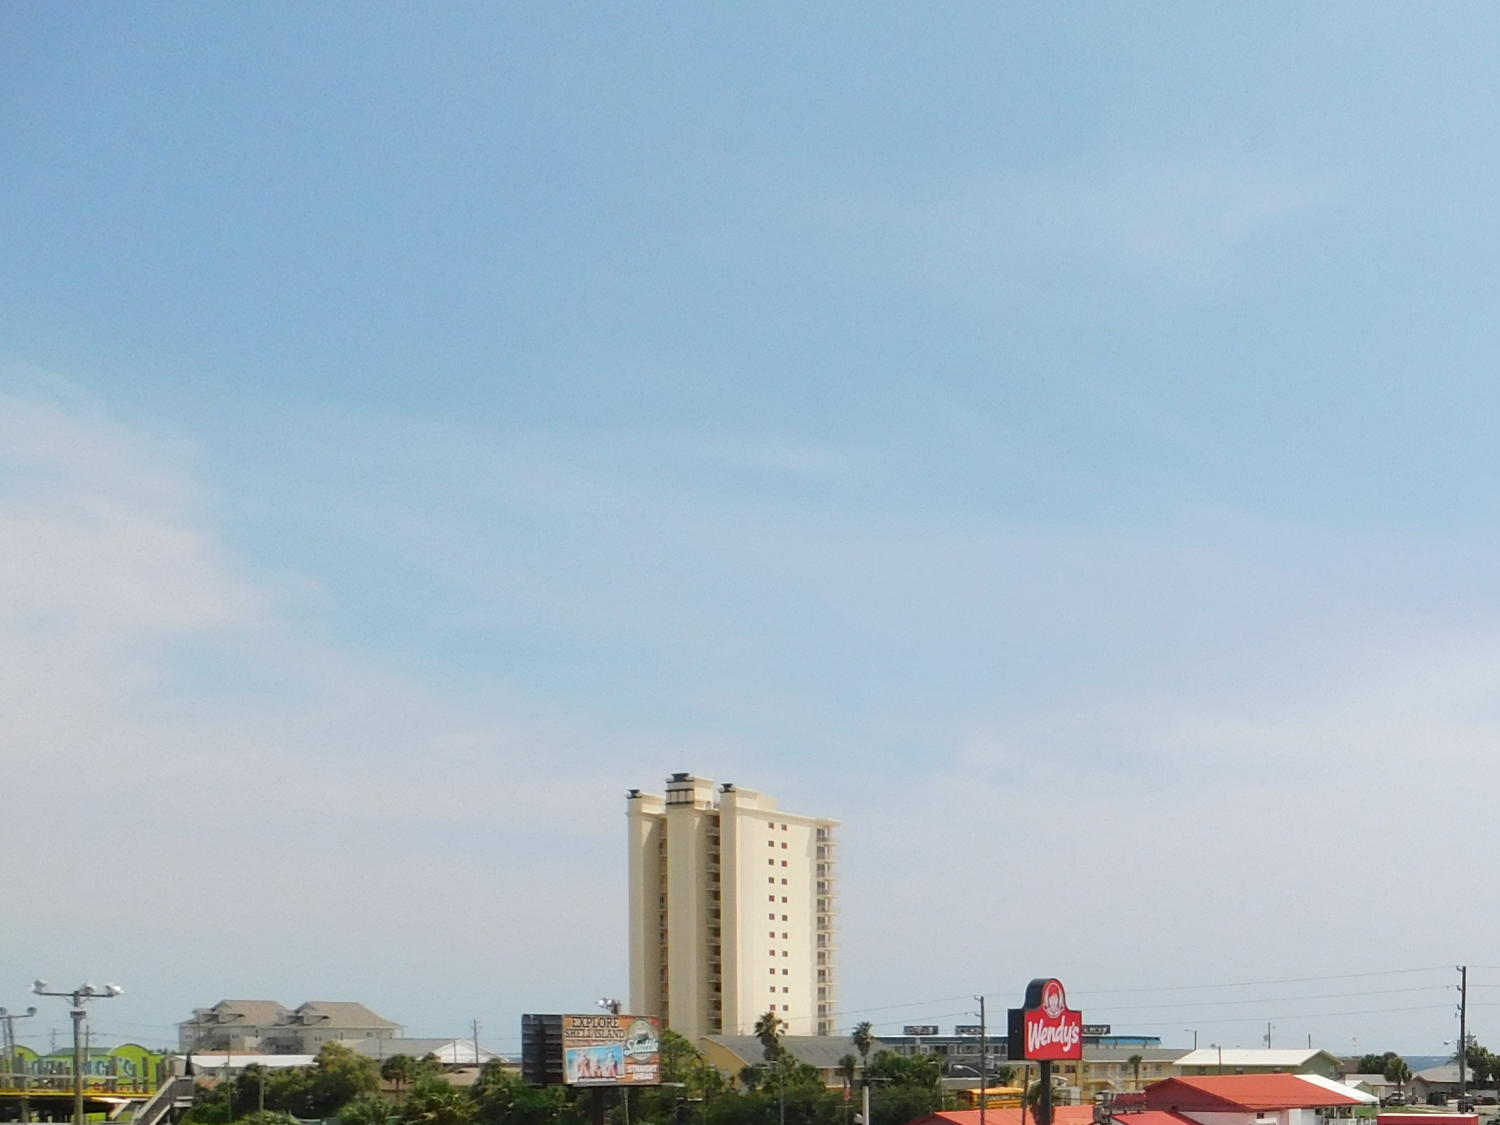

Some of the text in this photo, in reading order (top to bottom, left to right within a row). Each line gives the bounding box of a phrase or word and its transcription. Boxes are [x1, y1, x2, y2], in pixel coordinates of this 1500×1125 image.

[572, 1016, 619, 1028] EXPLORE
[564, 1028, 625, 1038] SHELL ISLAND
[1028, 1015, 1079, 1053] Wendy's
